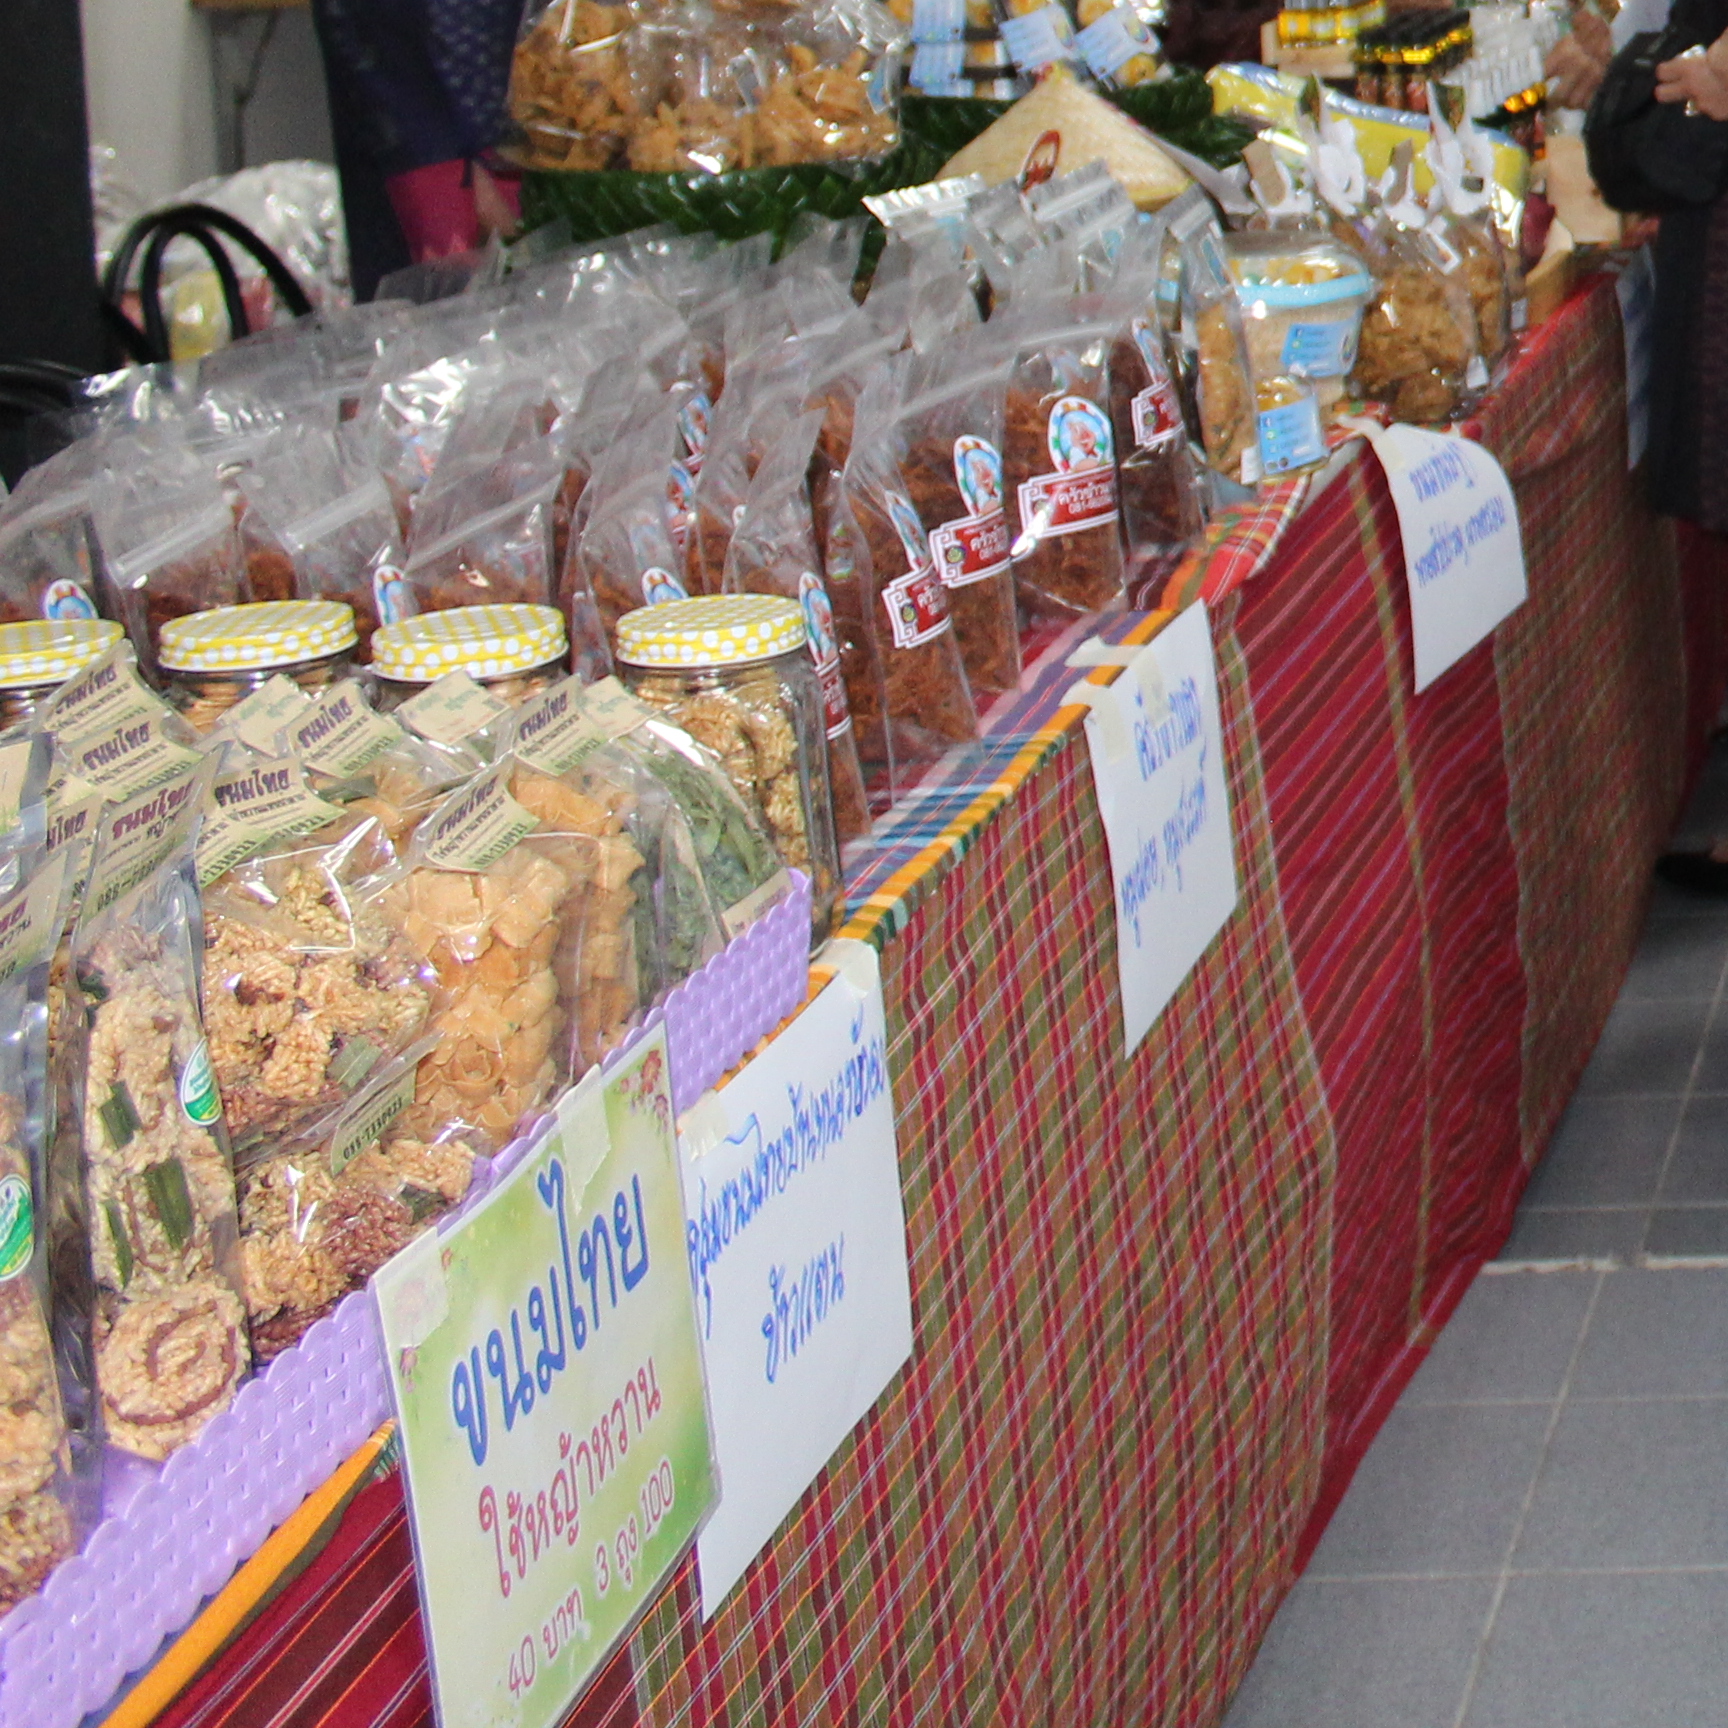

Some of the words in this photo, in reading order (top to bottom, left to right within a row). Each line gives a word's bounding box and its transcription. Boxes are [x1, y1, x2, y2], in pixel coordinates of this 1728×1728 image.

[83, 720, 151, 771] ขนมไทย
[214, 768, 290, 807] ขนมไทย
[451, 1157, 650, 1467] ขนมไทย
[761, 1231, 846, 1384] ข้าวแตน
[478, 1355, 662, 1599] ใช้หญ้าหวาน
[507, 1633, 536, 1699] 40
[543, 1588, 584, 1660] บาท
[596, 1544, 610, 1592] 3
[616, 1520, 638, 1588] ถุง
[642, 1458, 675, 1534] 100
